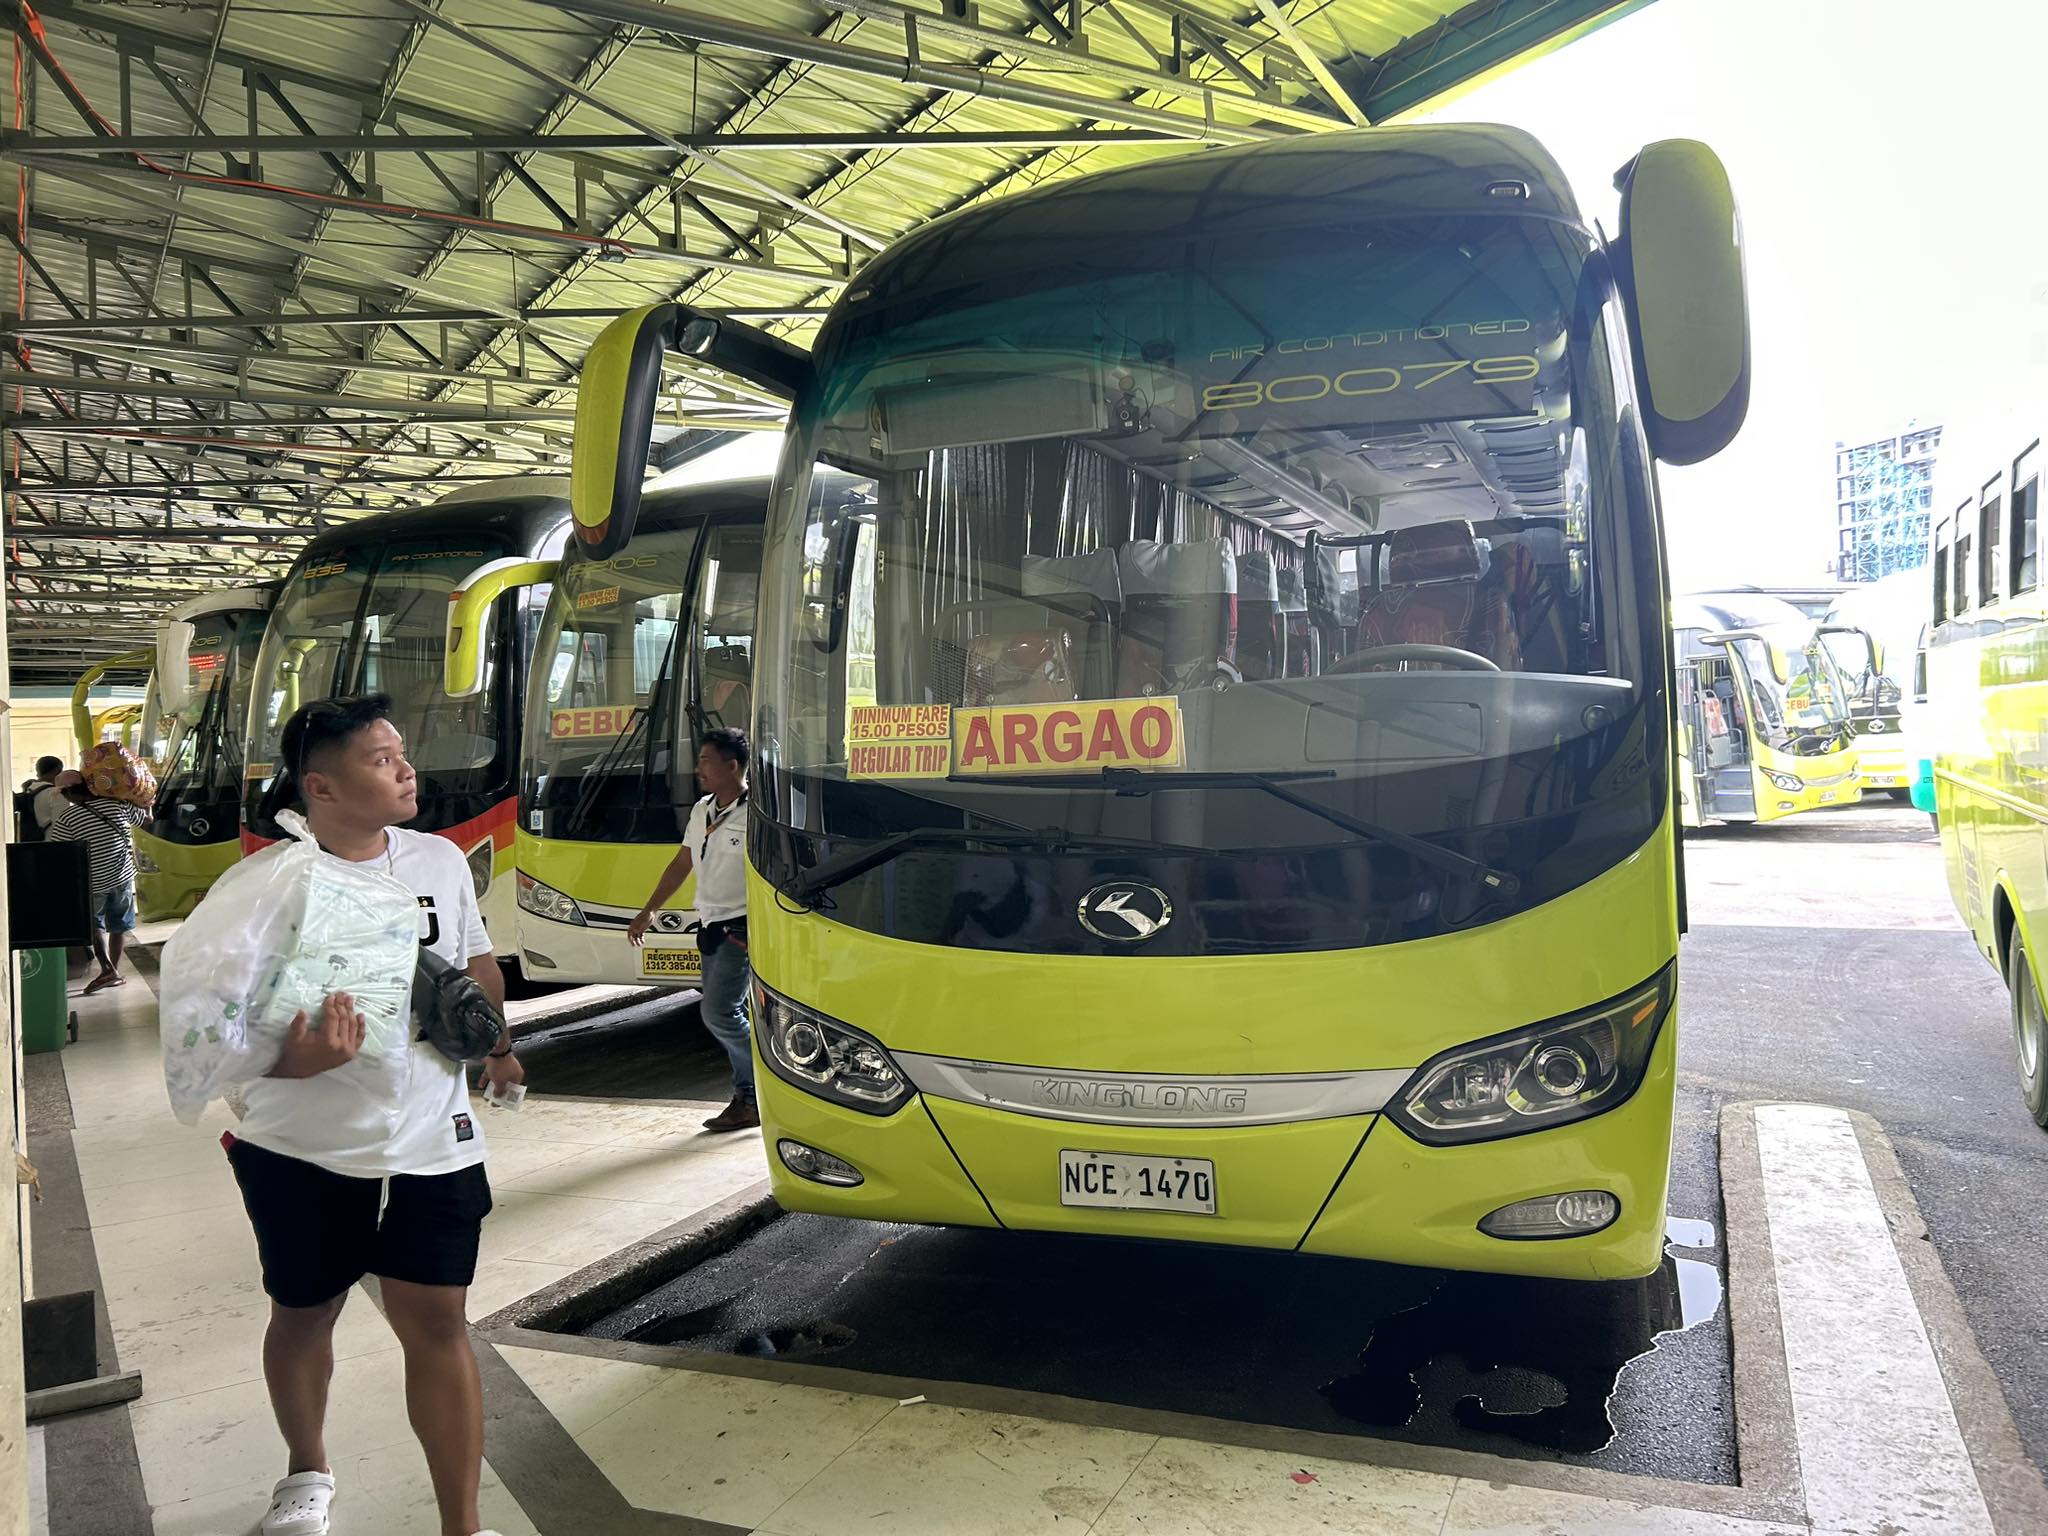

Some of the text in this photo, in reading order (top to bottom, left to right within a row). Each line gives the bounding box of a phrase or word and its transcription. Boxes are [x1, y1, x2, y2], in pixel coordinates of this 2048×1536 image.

[1209, 318, 1531, 362] AIR CONDITIONED
[1202, 355, 1541, 411] 80079
[551, 709, 635, 737] CEBU
[852, 706, 949, 724] MINIMUM FARE
[852, 722, 947, 738] 15.00 PESOS
[960, 705, 1174, 766] ARGAO
[851, 745, 948, 774] REGULAR TRIP
[647, 953, 700, 961] REGISTERED
[1064, 1162, 1210, 1202] NCE 1470
